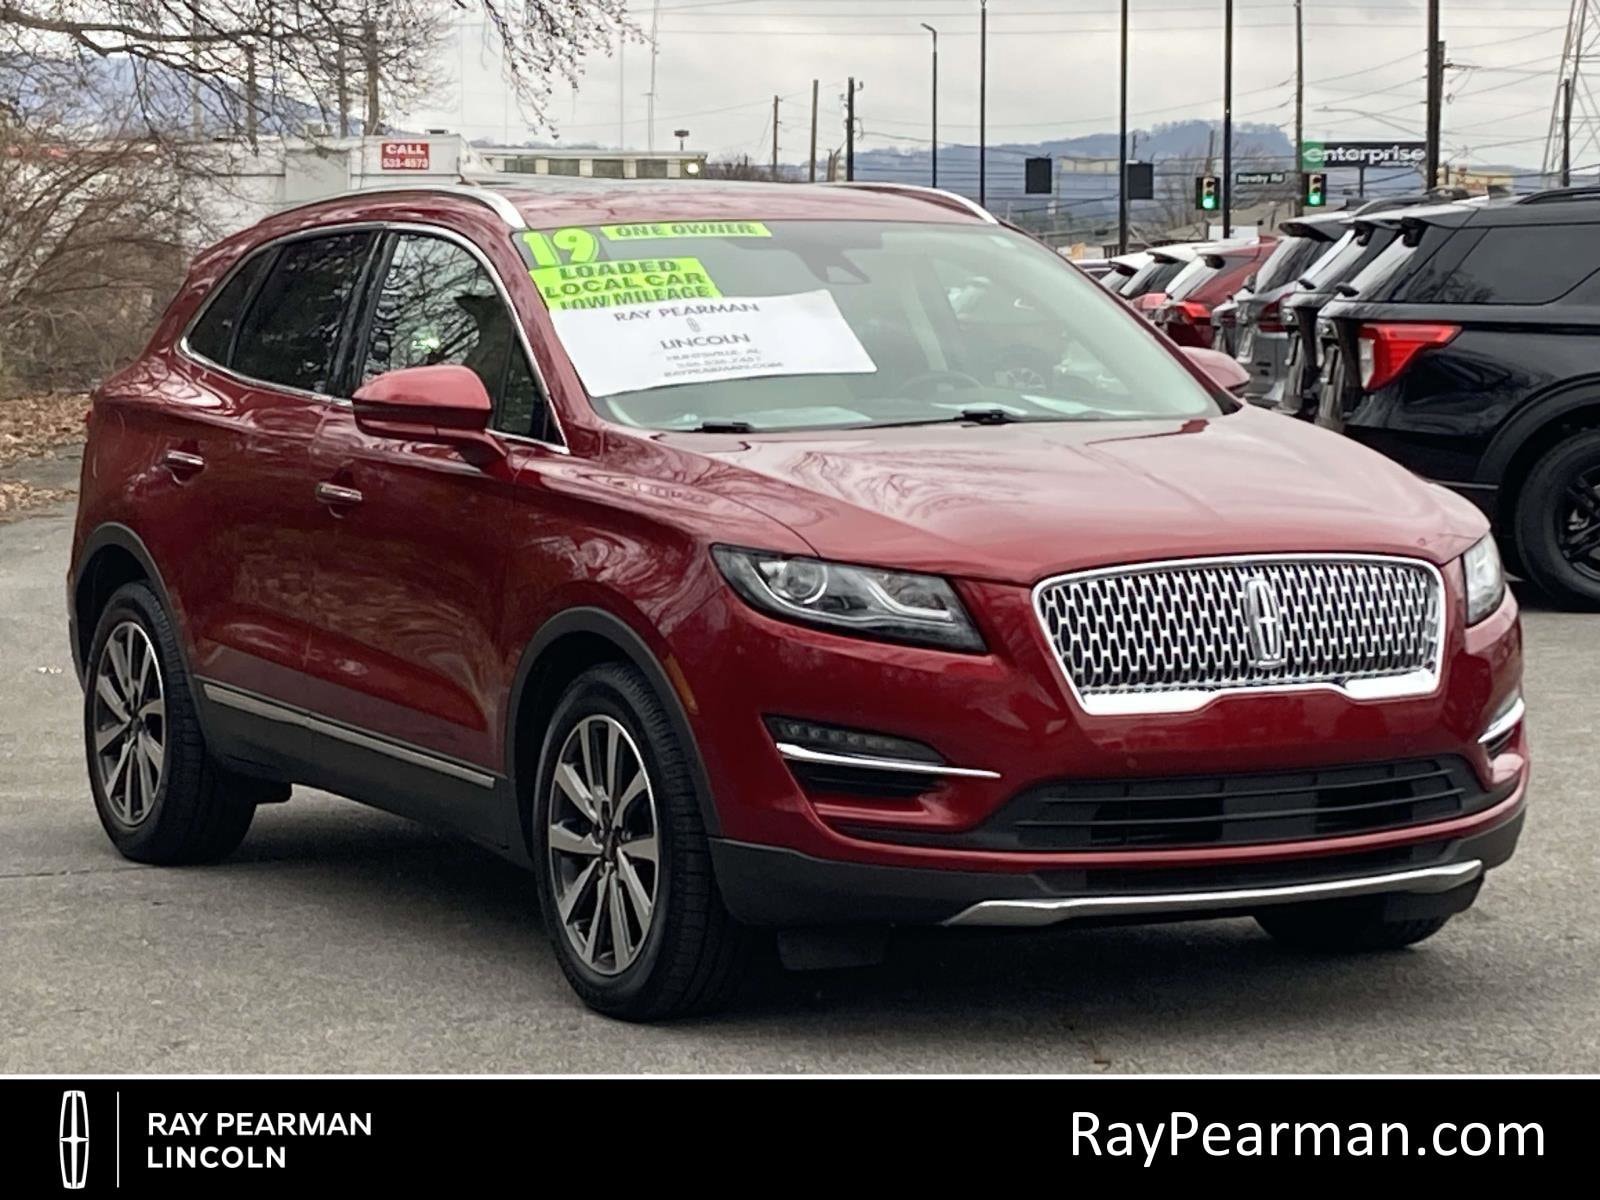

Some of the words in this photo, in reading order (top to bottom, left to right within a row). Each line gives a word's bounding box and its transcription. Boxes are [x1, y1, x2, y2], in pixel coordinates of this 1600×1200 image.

[386, 144, 425, 154] CALL
[1302, 145, 1426, 164] enterprise
[616, 226, 664, 237] ONE
[671, 224, 754, 236] OWNER
[523, 228, 600, 266] 19
[559, 260, 680, 280] LOADED
[544, 276, 641, 299] LOCAL
[645, 271, 706, 288] CAR
[612, 286, 711, 305] MILEAGE
[614, 311, 652, 323] RAY
[659, 303, 760, 318] PEARMAN
[660, 333, 752, 350] LINCOLN
